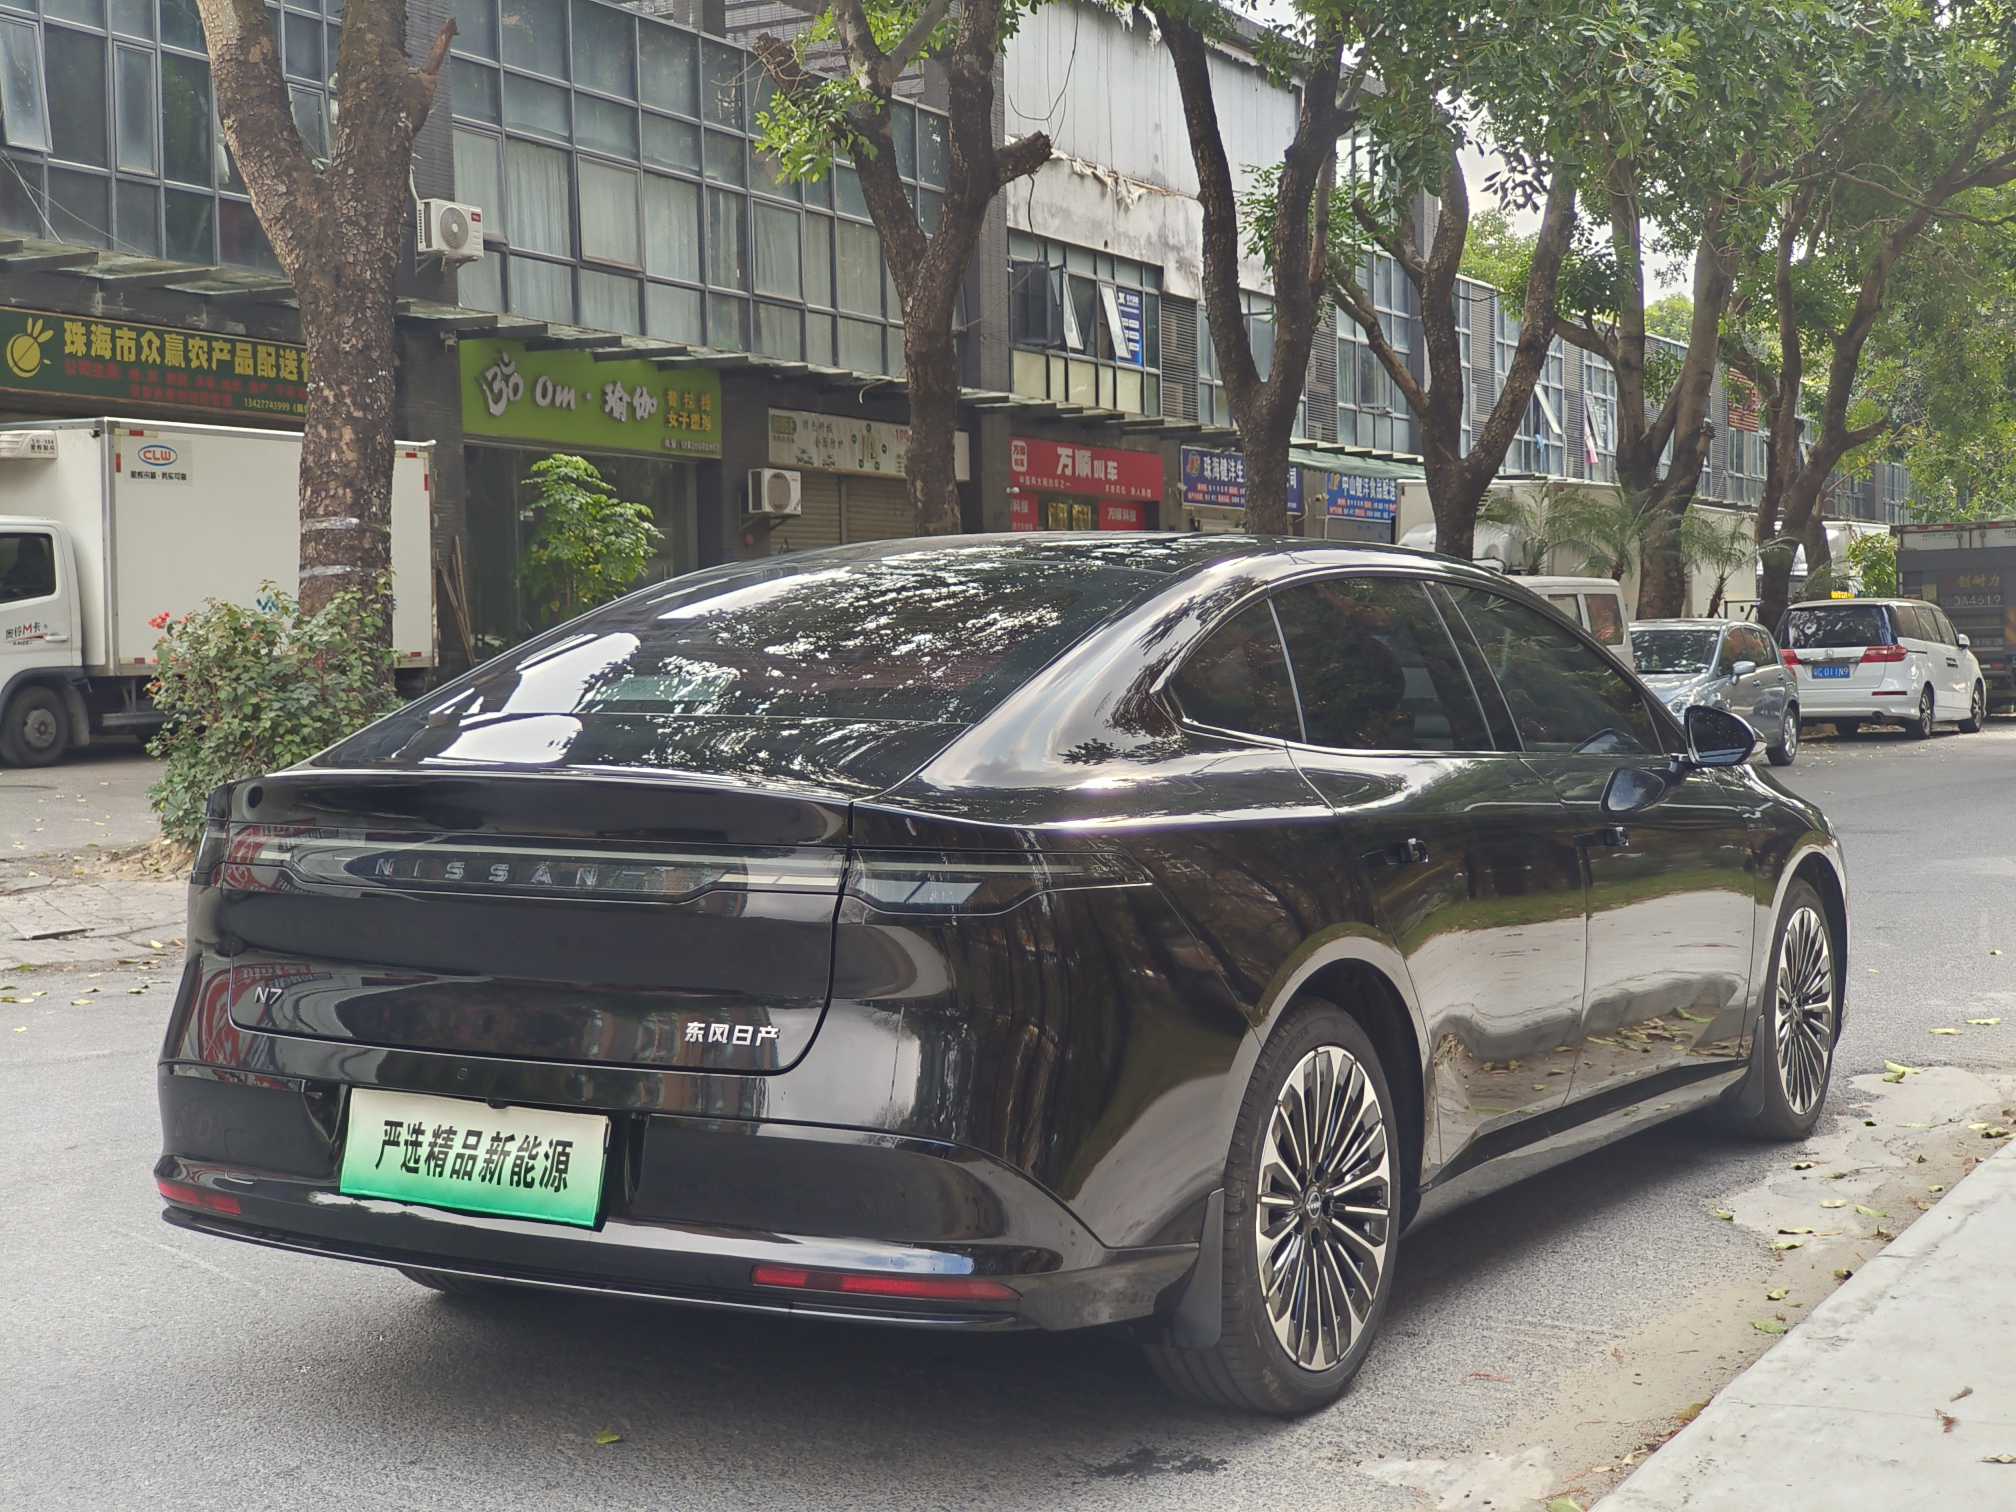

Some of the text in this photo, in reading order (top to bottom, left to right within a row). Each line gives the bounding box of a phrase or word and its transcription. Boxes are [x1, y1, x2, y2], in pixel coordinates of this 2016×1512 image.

[375, 858, 598, 887] NISSAN
[254, 986, 283, 1005] N7
[684, 1021, 779, 1047] 东风日产
[375, 1119, 573, 1193] 严选精品新能源
